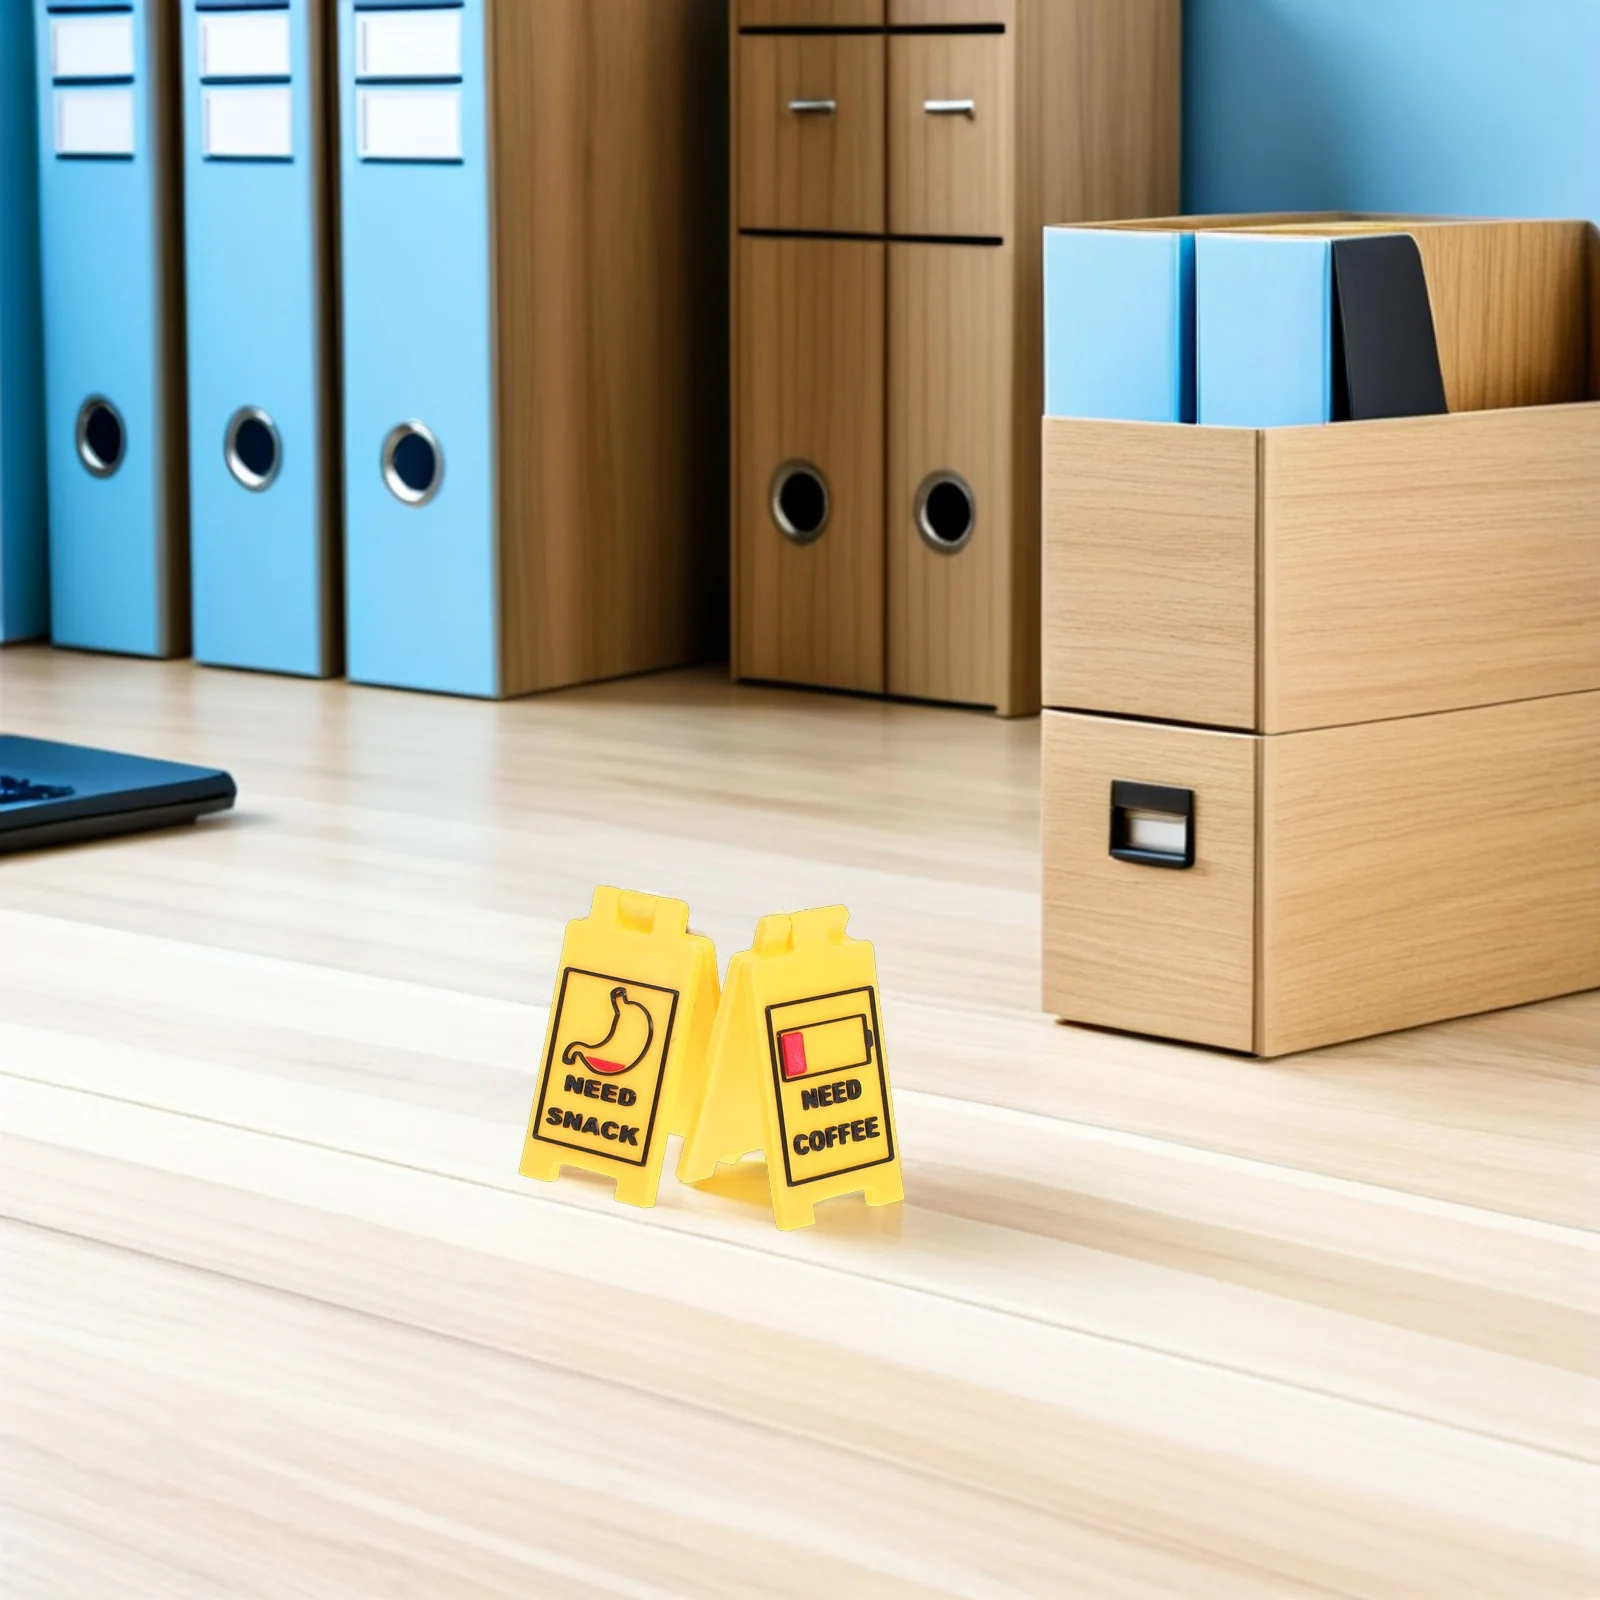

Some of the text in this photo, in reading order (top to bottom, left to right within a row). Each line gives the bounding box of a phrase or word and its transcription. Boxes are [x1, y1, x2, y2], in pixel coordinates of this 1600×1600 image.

[563, 1074, 637, 1107] NEED
[801, 1079, 861, 1110] NEED
[546, 1107, 640, 1146] SNACK
[793, 1117, 880, 1155] COFFEE
